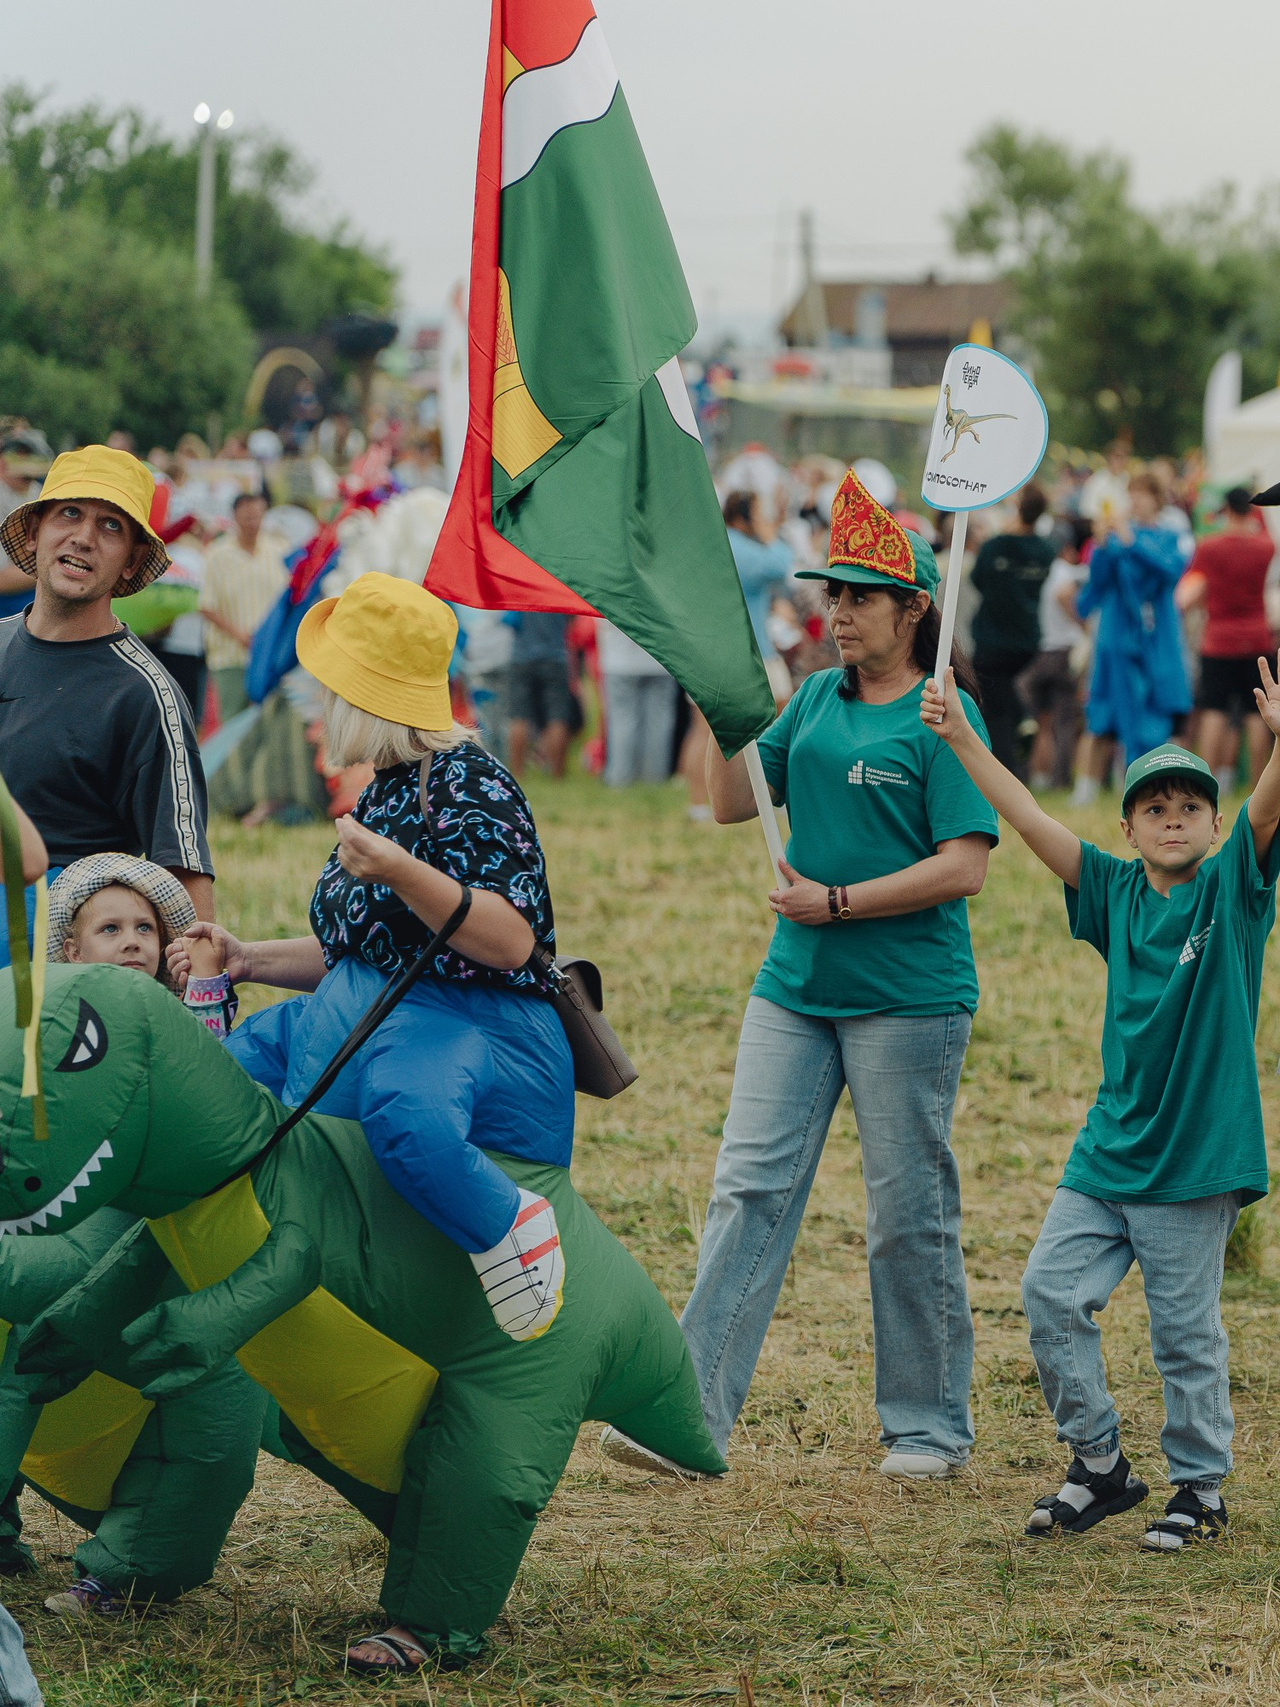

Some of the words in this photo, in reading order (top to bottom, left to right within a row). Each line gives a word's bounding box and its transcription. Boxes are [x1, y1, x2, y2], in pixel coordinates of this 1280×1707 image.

[962, 361, 981, 376] ДИНО
[864, 772, 909, 786] Муниципальный
[865, 766, 902, 779] Кемеровский
[864, 778, 882, 787] Округ
[188, 988, 224, 1003] FUN
